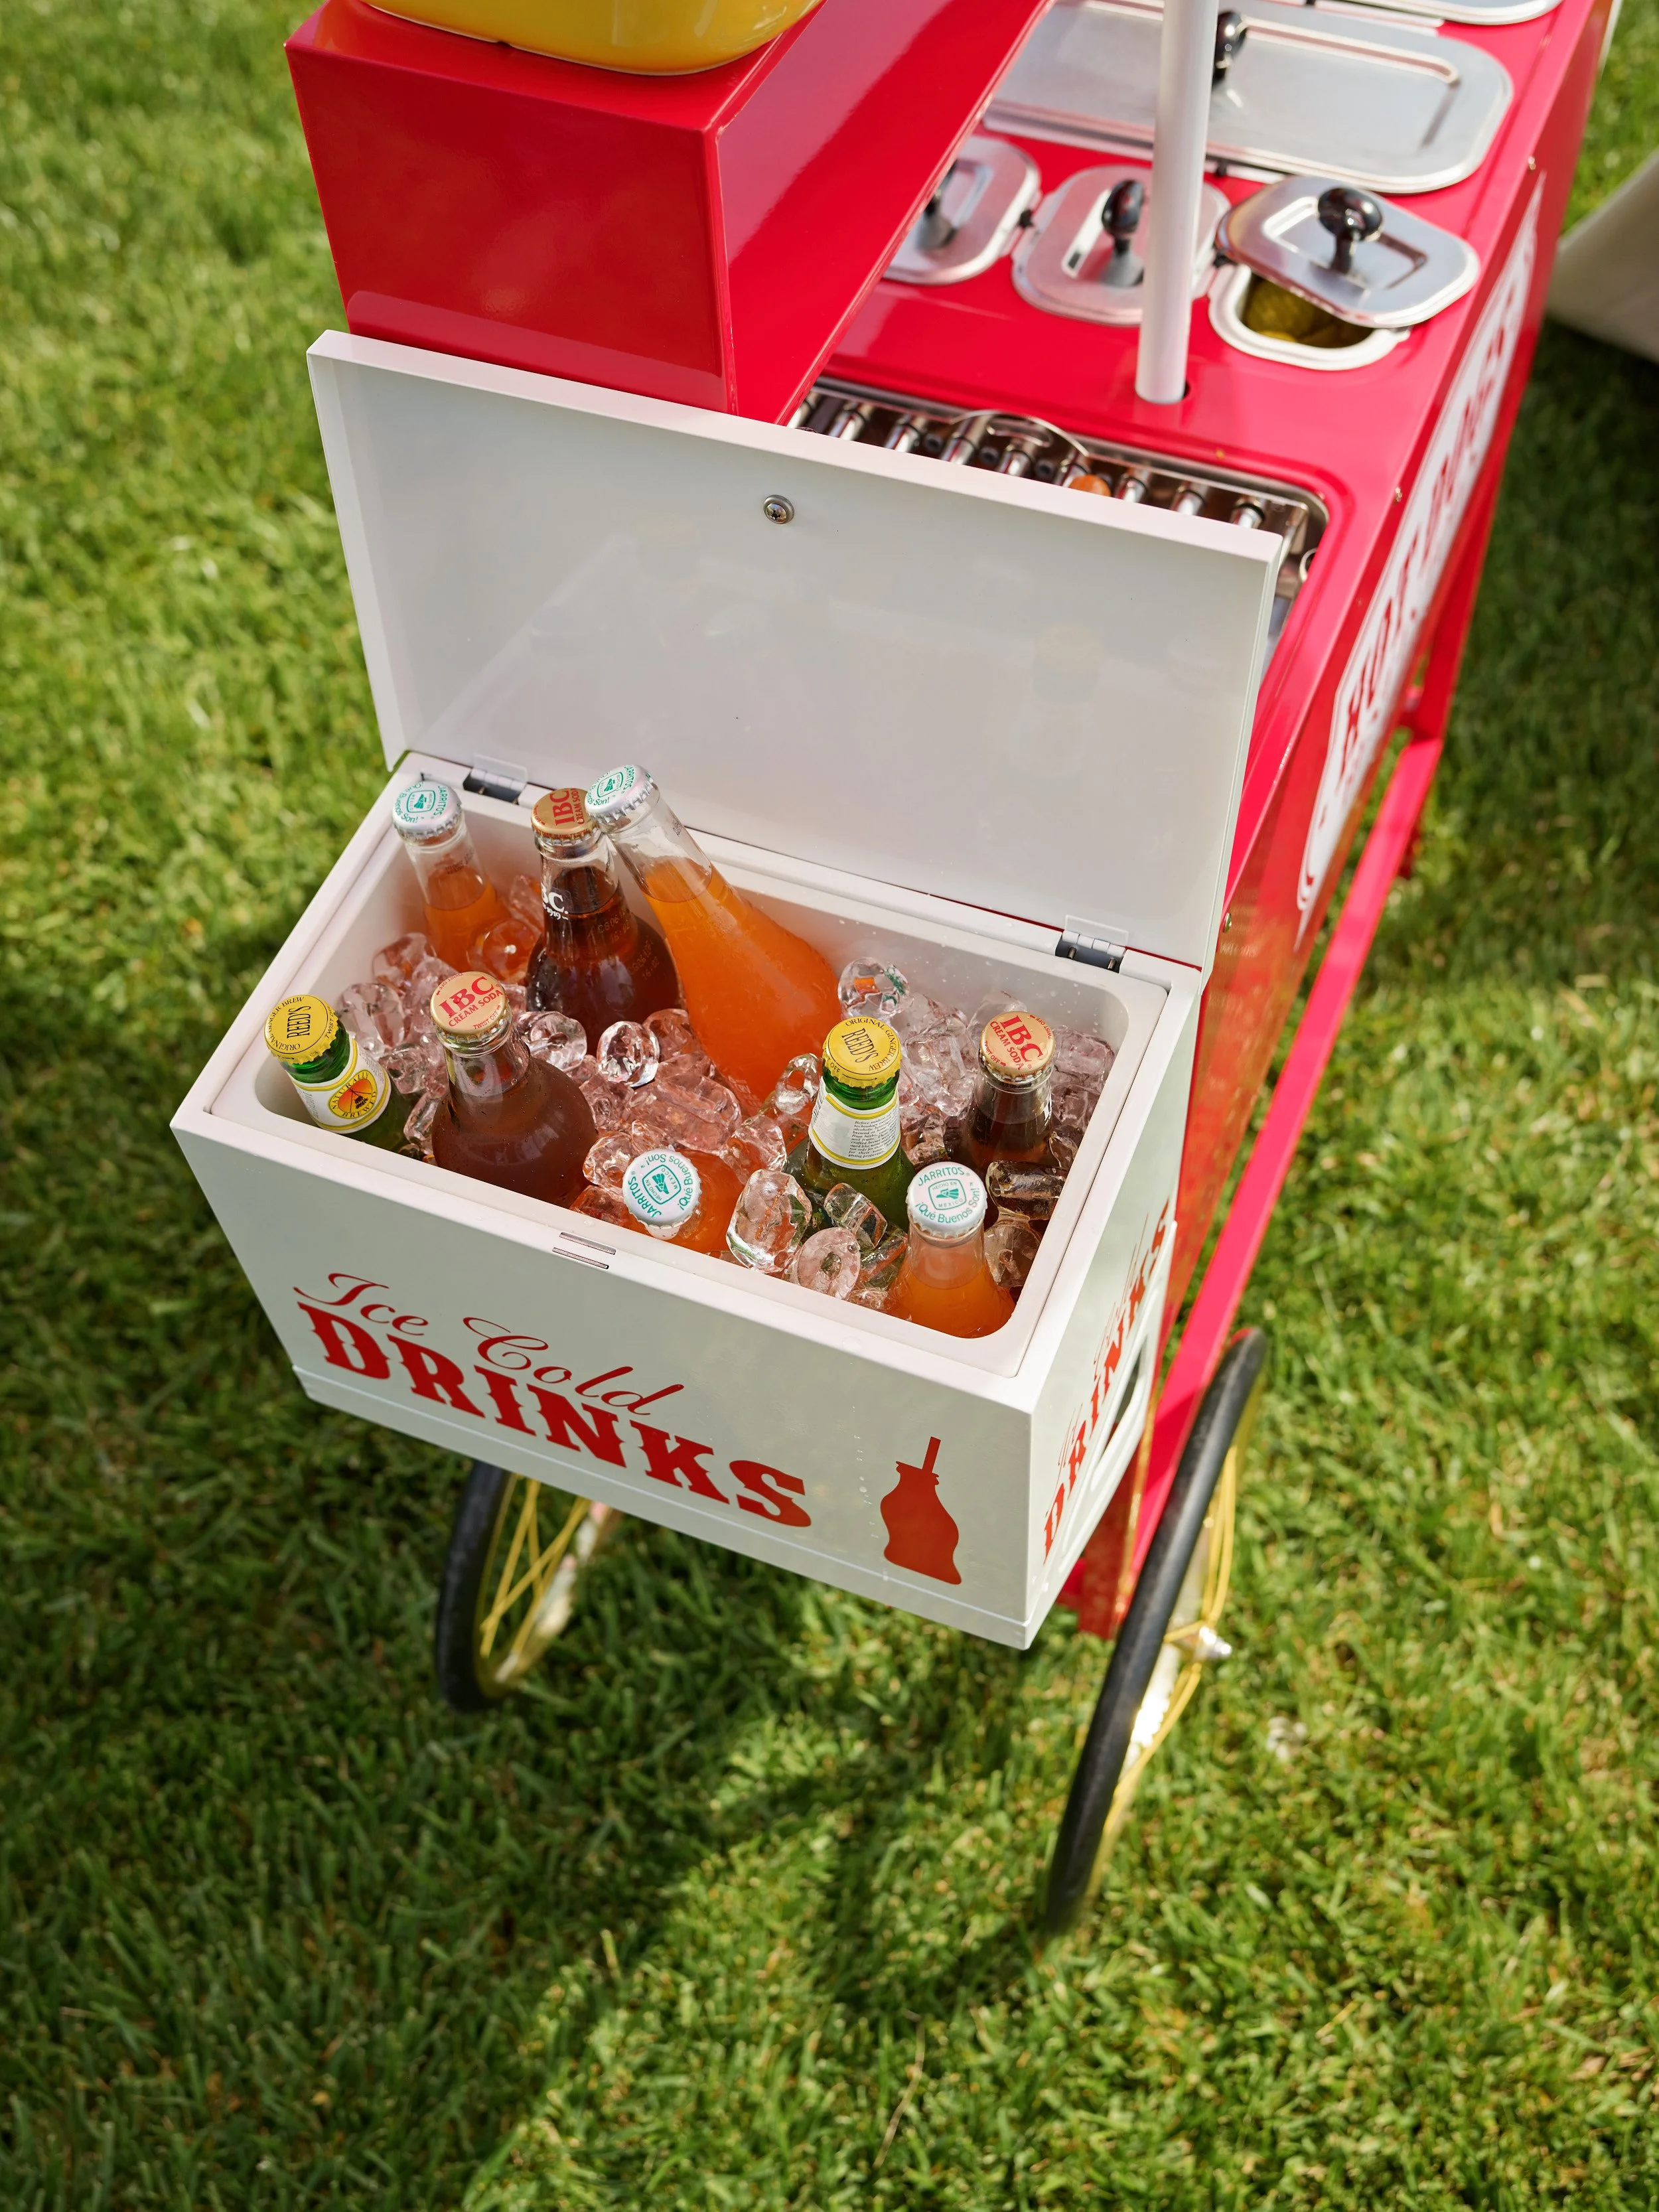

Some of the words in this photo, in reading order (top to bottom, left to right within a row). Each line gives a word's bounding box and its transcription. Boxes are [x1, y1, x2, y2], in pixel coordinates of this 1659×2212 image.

[433, 785, 448, 816] JARRITOS
[549, 790, 575, 826] IBC
[593, 796, 610, 806] Son!
[401, 813, 418, 824] Son!
[573, 803, 585, 824] CREAM
[281, 996, 305, 1007] BREW
[439, 976, 494, 1019] IBC
[448, 1004, 478, 1027] CREAM
[478, 990, 503, 1007] SODA
[268, 1006, 281, 1033] GINGER
[287, 1005, 311, 1039] REED'S
[324, 1017, 334, 1039] TWIST
[473, 1019, 490, 1029] TWIST
[490, 1010, 499, 1021] OFF
[845, 1017, 885, 1030] ORIGINAL
[1035, 1017, 1045, 1026] OFF
[269, 1033, 301, 1051] ORIGINAL
[885, 1029, 897, 1057] GINGER
[999, 1015, 1044, 1062] IBC
[1043, 1025, 1052, 1039] TWIST
[841, 1027, 879, 1063] REED'S
[989, 1021, 1011, 1047] CREAM
[1007, 1047, 1025, 1070] SODA
[830, 1062, 841, 1073] OFF
[868, 1056, 891, 1071] BREW
[990, 1055, 1001, 1064] OFF
[332, 1072, 370, 1110] NATURALLY
[342, 1091, 376, 1118] BREWED
[644, 1153, 667, 1165] Son!
[668, 1155, 693, 1185] Buenos
[661, 1167, 678, 1189] MEXICO
[918, 1167, 965, 1187] JARRITOS
[628, 1176, 662, 1218] JARRITOS
[649, 1186, 662, 1201] HECHO
[677, 1187, 693, 1211] ¡Qué
[938, 1198, 964, 1207] MEXICO
[914, 1202, 936, 1220] ¡Qué
[938, 1207, 973, 1224] Buenos
[968, 1188, 980, 1208] Son!
[293, 1271, 429, 1337] Ice
[462, 1317, 685, 1416] Cold
[1044, 1197, 1169, 1566] DRINKS
[297, 1300, 813, 1528] DRINKS
